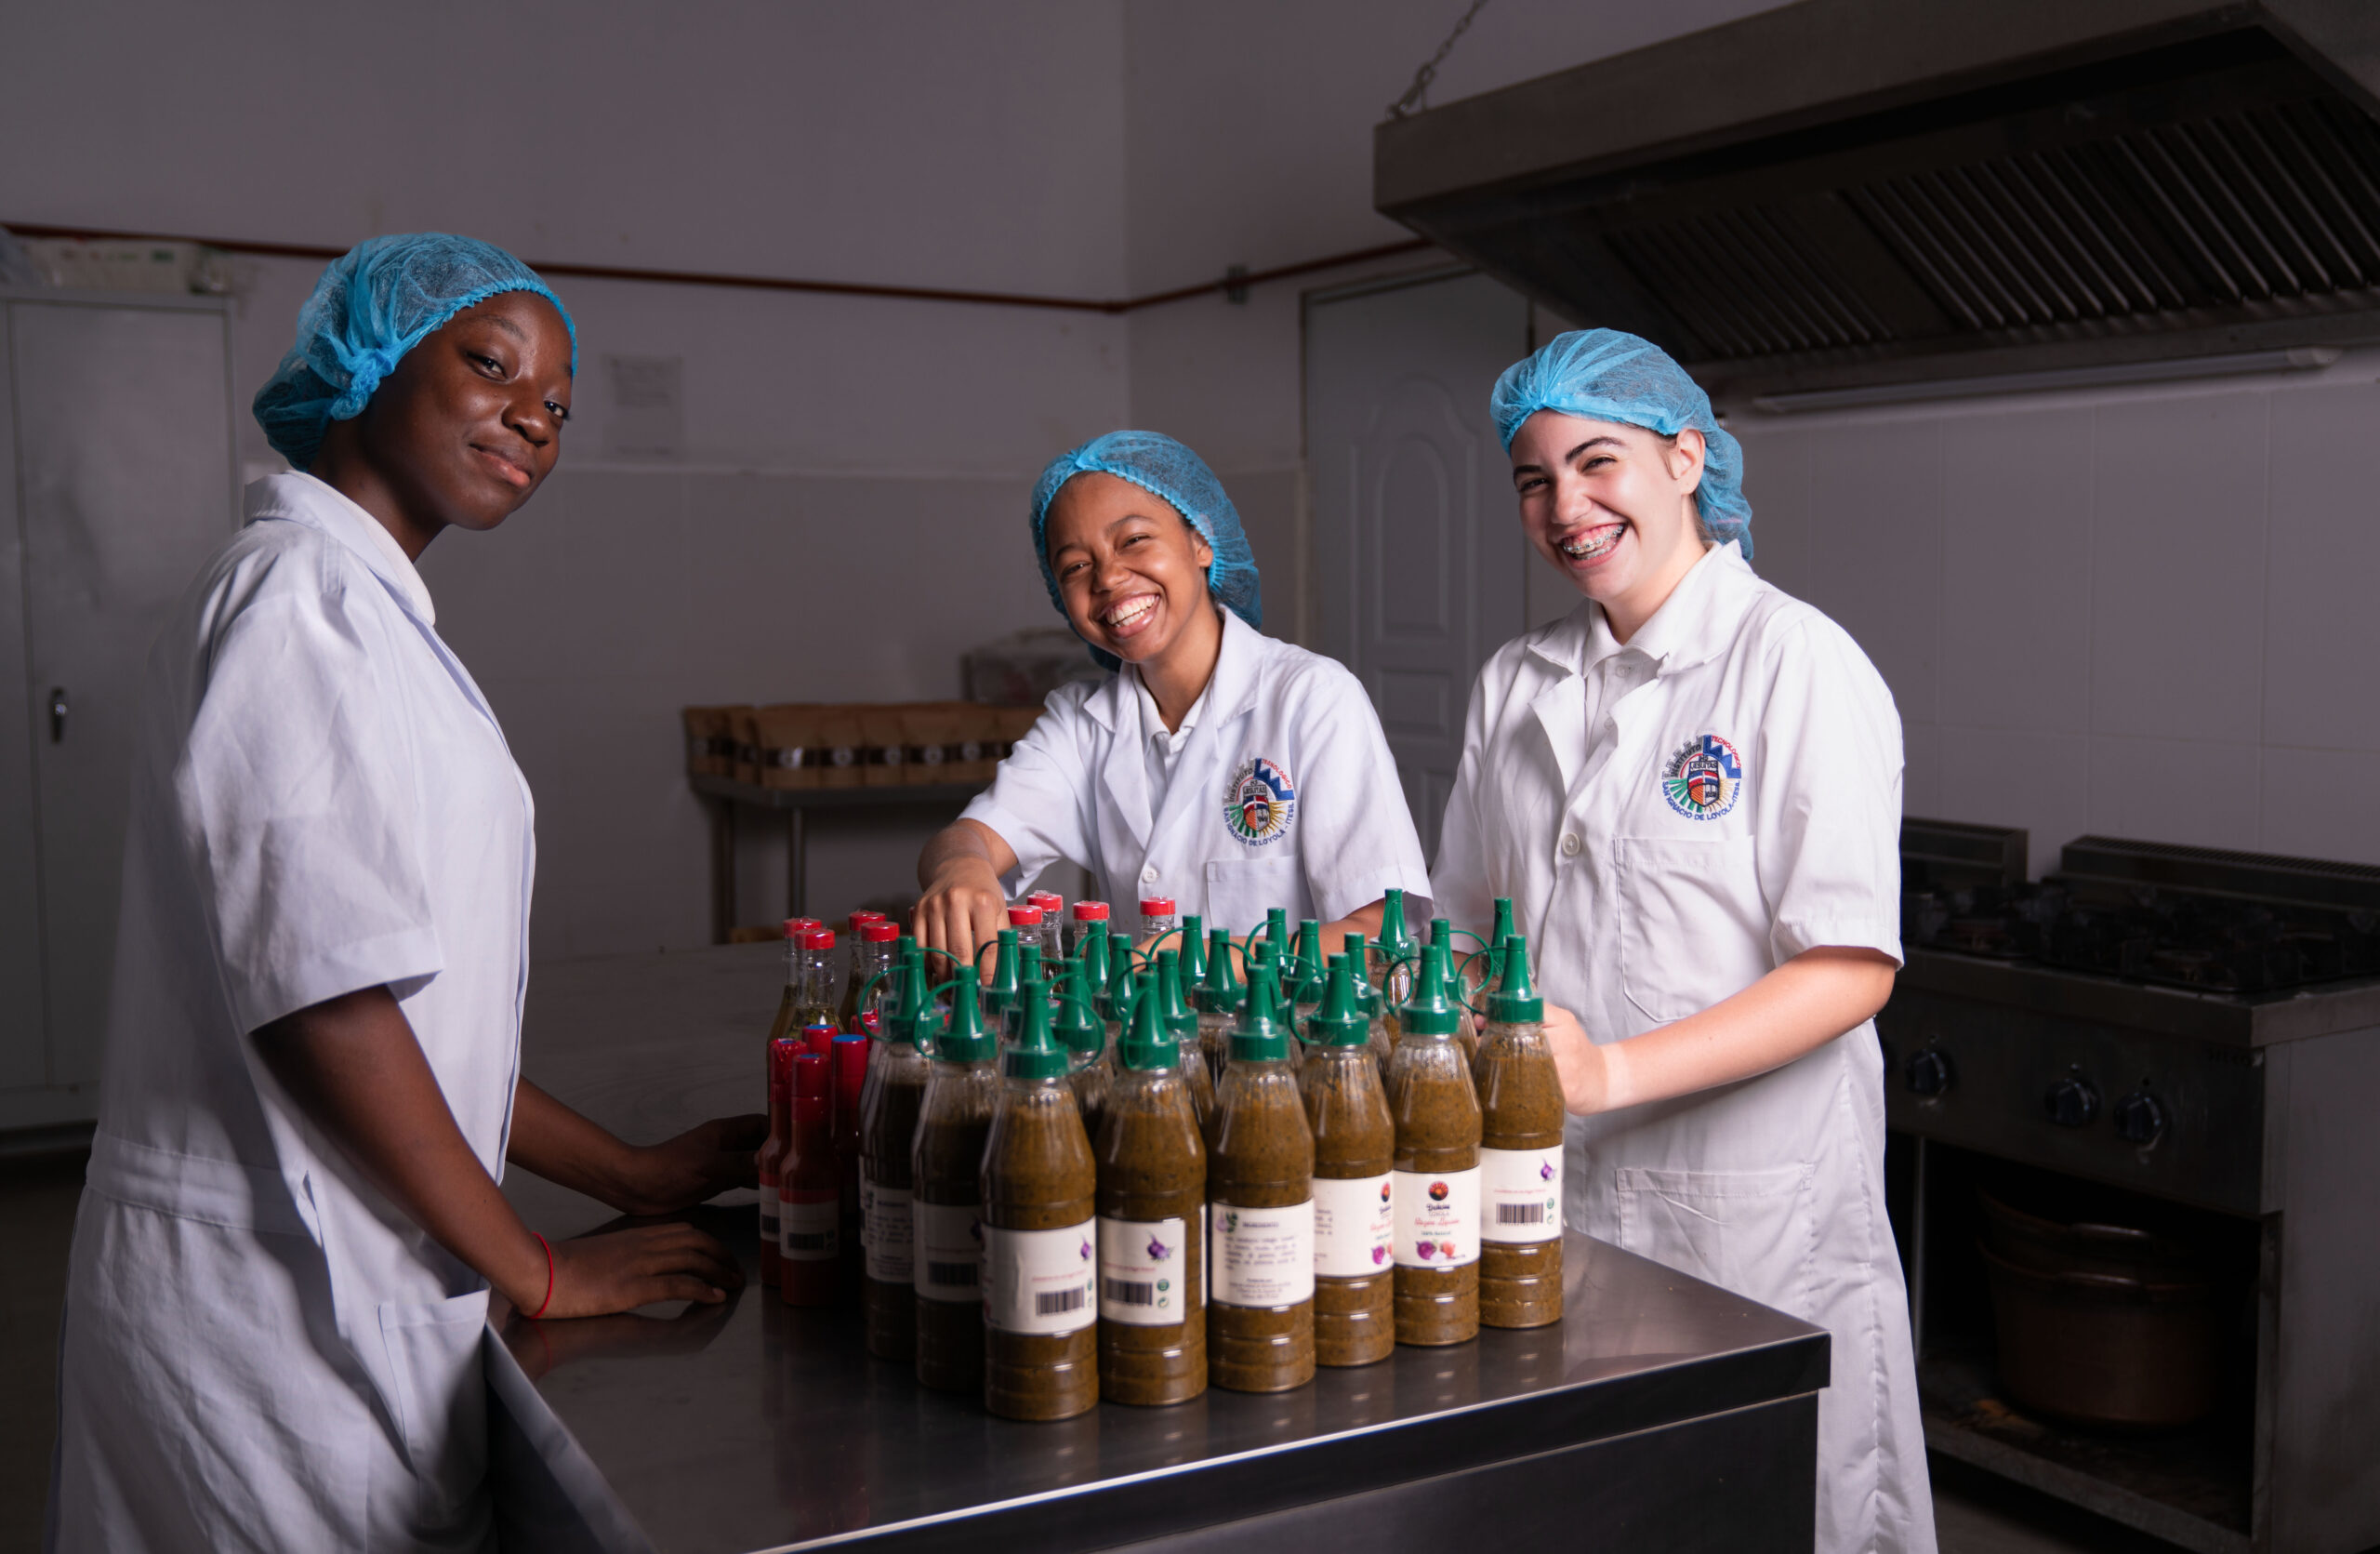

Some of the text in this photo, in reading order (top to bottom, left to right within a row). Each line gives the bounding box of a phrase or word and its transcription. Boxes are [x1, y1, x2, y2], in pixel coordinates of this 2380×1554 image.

[1671, 744, 1701, 777] INSTITUTO
[1229, 768, 1253, 803] INSTITUTO
[1666, 795, 1693, 818] IGNACIO
[1707, 803, 1733, 820] LOYOLA
[1226, 822, 1248, 844] IGNACIO
[1258, 829, 1286, 846] LOYOLA
